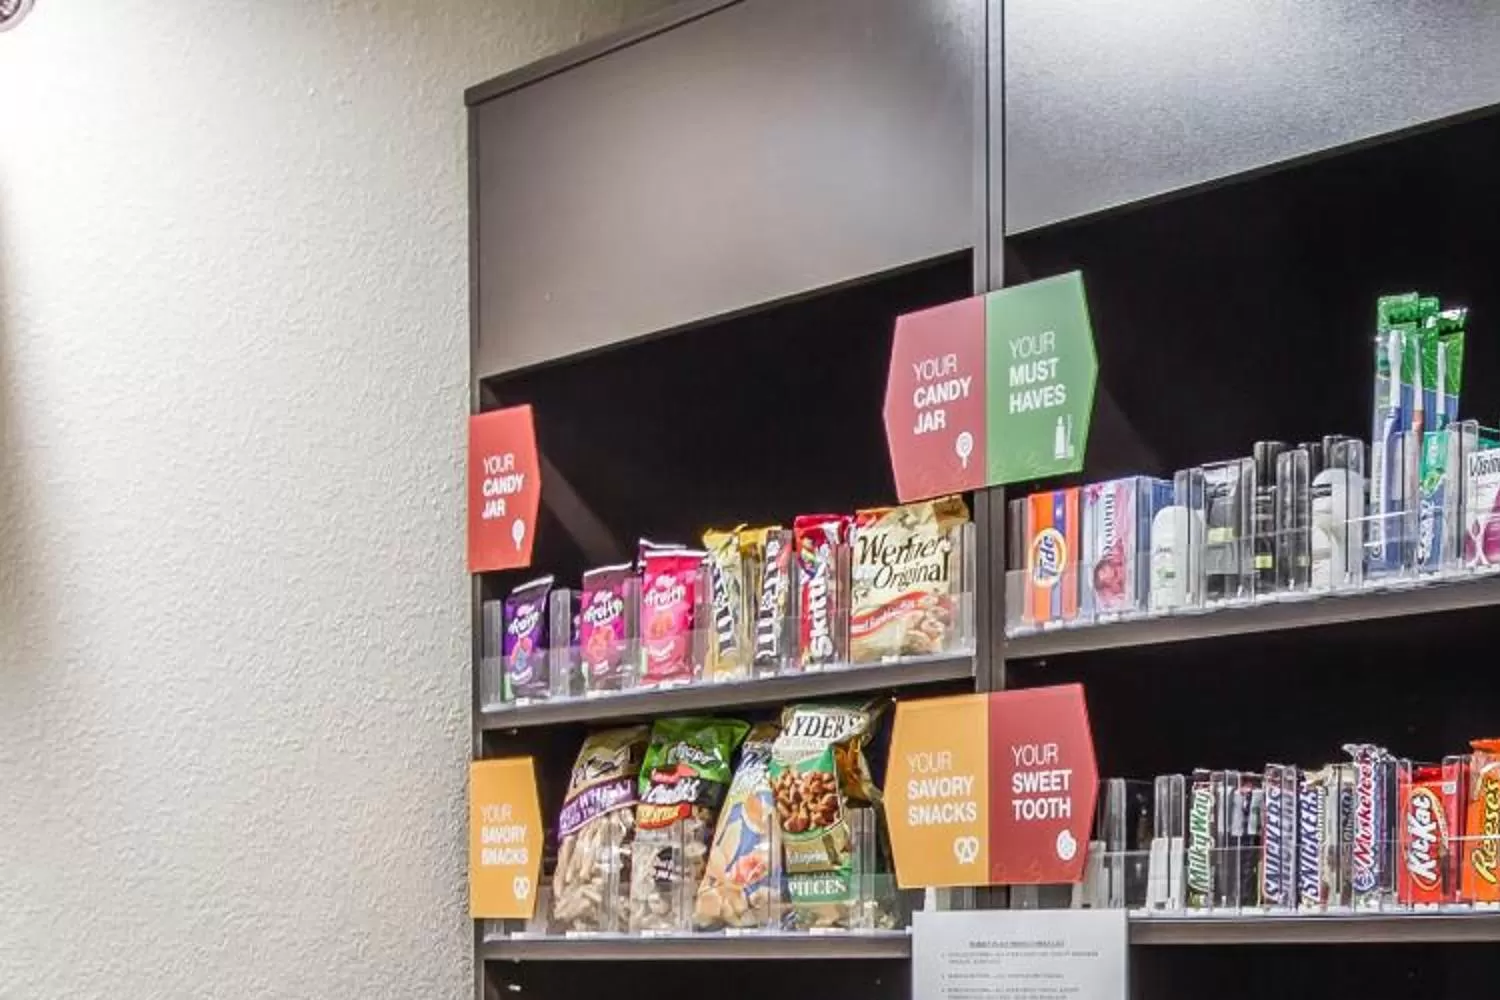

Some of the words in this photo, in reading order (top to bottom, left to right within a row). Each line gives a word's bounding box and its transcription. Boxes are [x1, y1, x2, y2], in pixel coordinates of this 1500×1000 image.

[1008, 331, 1056, 359] YOUR
[912, 353, 957, 381] YOUR
[1009, 357, 1060, 387] MUST
[913, 376, 972, 408] CANDY
[1009, 384, 1066, 414] HAVES
[913, 409, 946, 434] JAR
[483, 453, 515, 474] YOUR
[482, 474, 524, 496] CANDY
[482, 498, 505, 519] JAR
[1039, 534, 1058, 582] Tide
[906, 751, 952, 773] YOUR
[1011, 743, 1058, 766] YOUR
[907, 776, 974, 800] SAVORY
[1012, 770, 1072, 794] SWEET
[481, 803, 512, 822] YOUR
[908, 801, 977, 826] SNACKS
[1012, 798, 1071, 821] TOOTH
[481, 824, 526, 844] SAVORY
[481, 848, 528, 865] SNACKS
